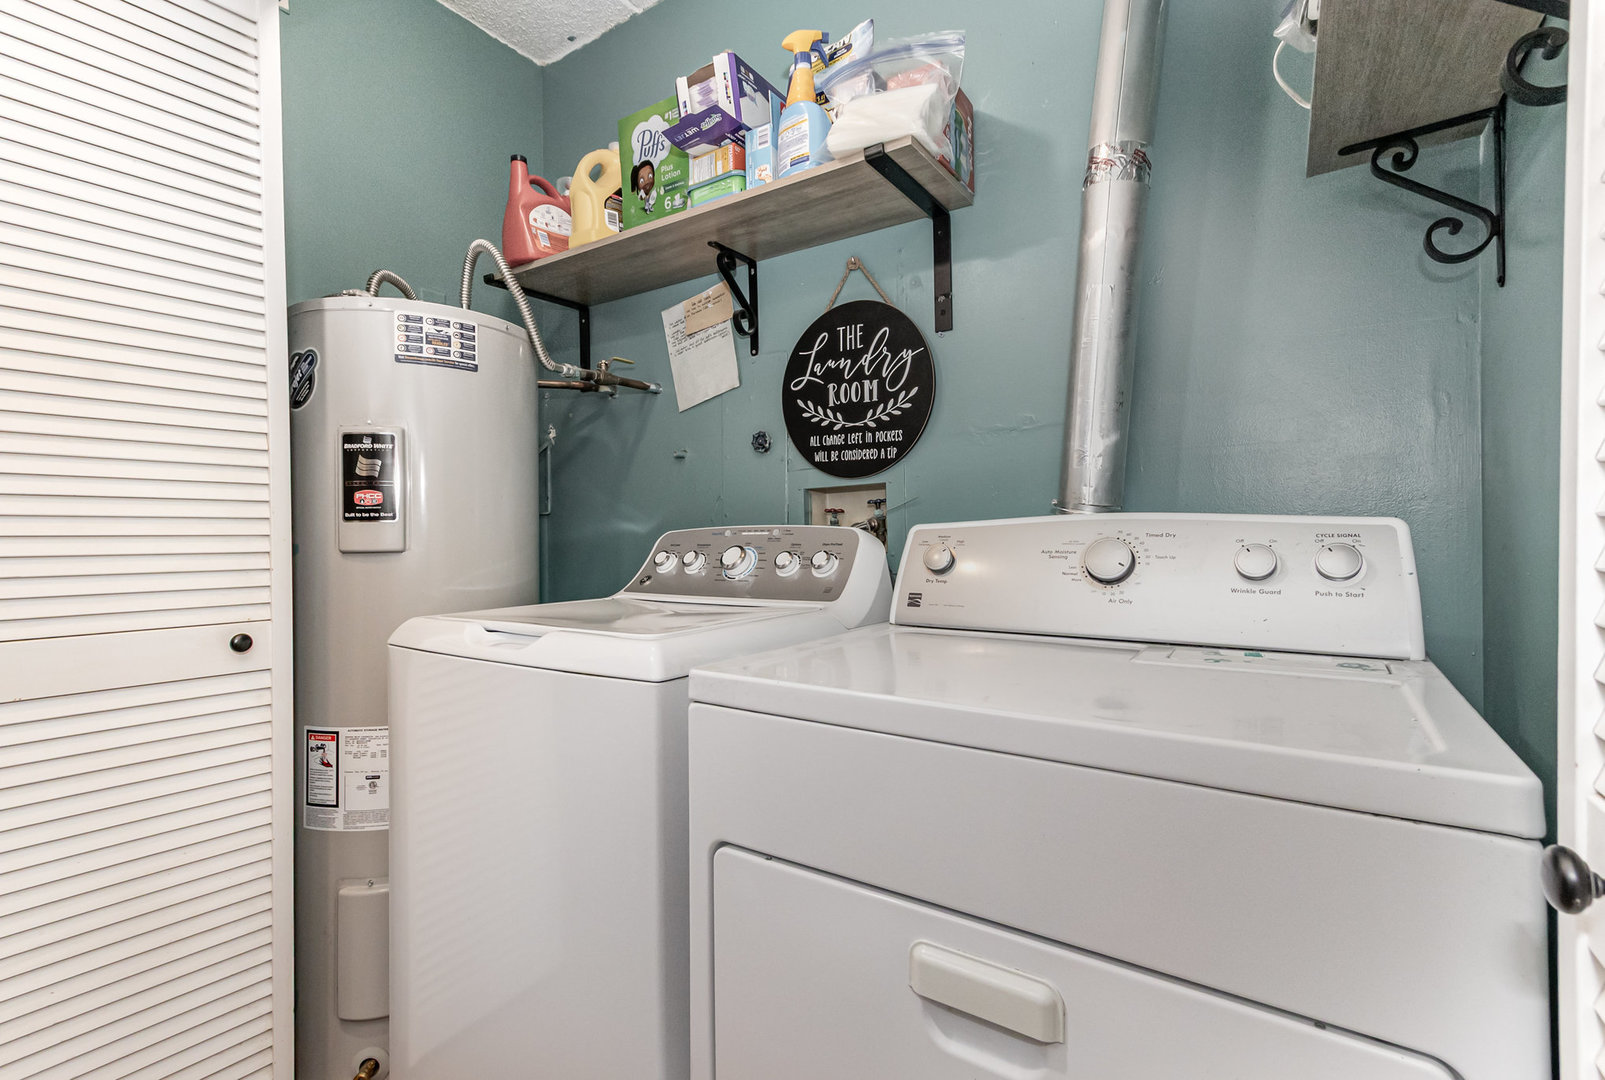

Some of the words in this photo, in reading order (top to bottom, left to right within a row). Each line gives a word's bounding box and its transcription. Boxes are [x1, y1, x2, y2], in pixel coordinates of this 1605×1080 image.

[637, 129, 665, 162] Puffs
[661, 164, 673, 173] Plus
[661, 169, 681, 182] Lotion
[664, 196, 672, 209] 6
[836, 323, 864, 351] THE
[790, 326, 924, 392] Laundry
[826, 378, 880, 407] ROOM
[810, 436, 820, 446] ALL
[880, 448, 885, 459] A
